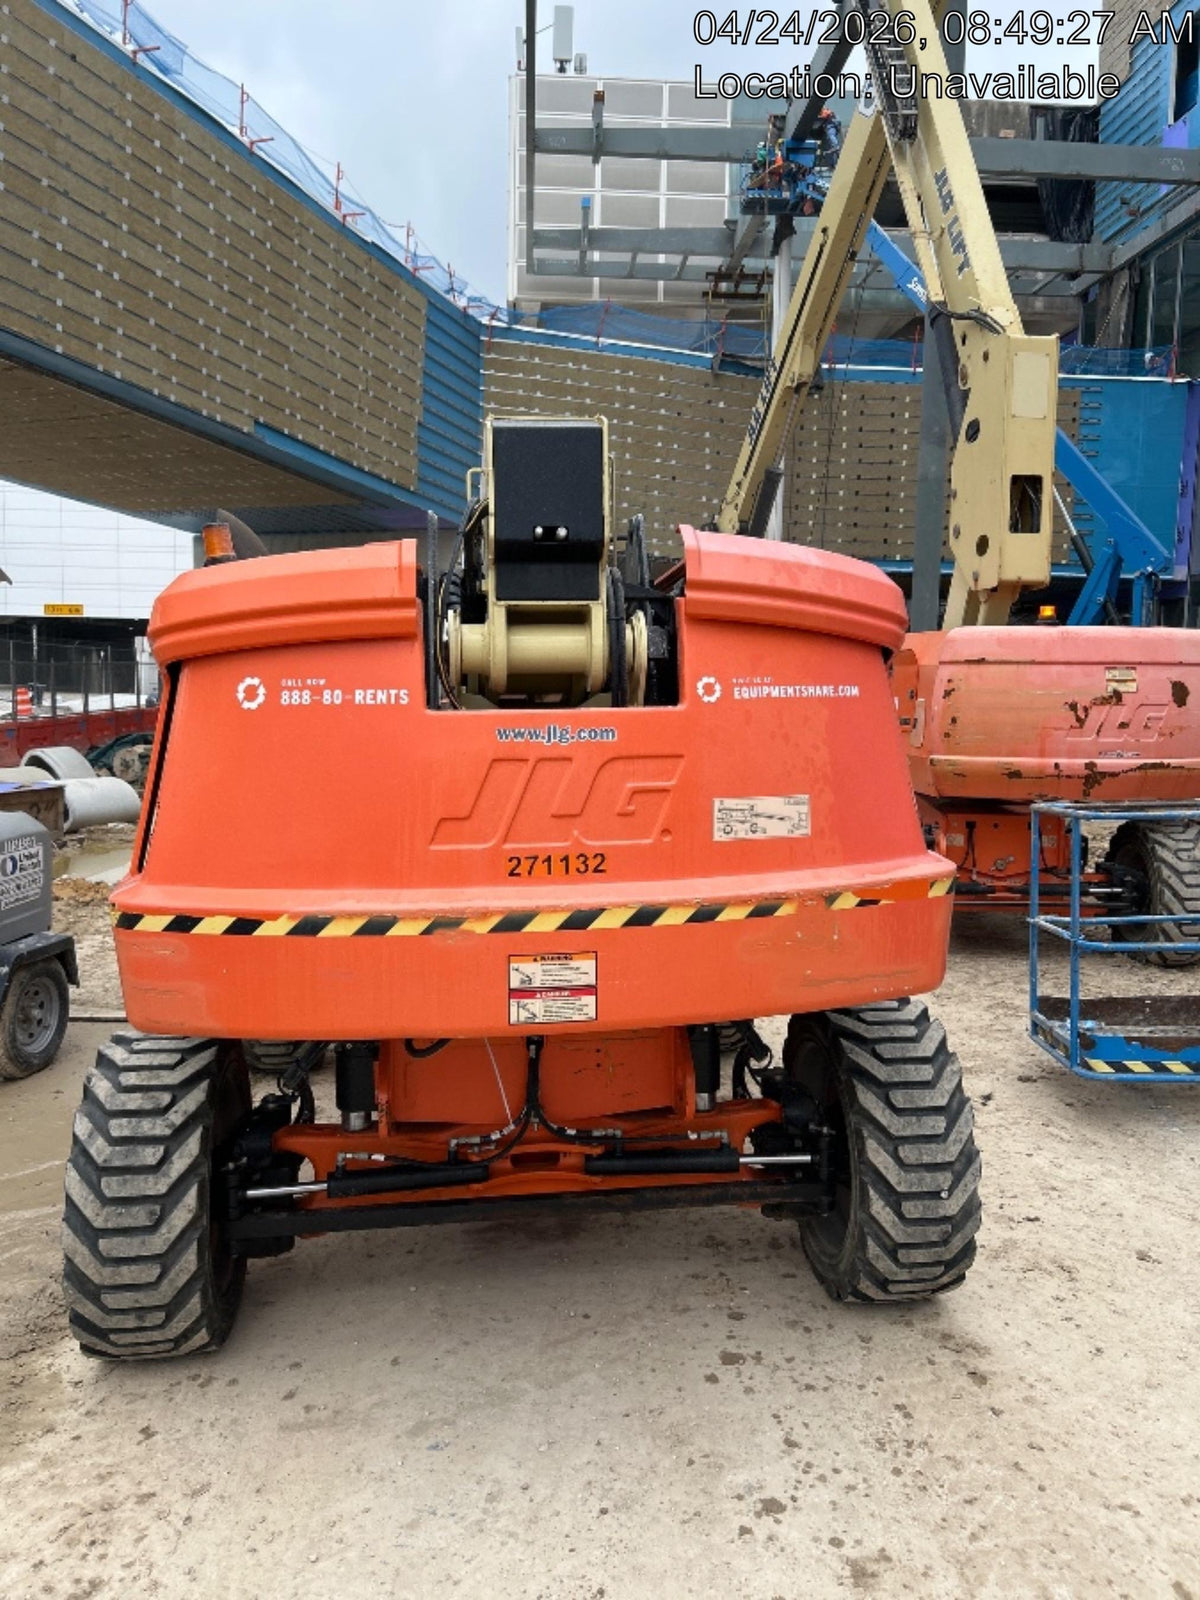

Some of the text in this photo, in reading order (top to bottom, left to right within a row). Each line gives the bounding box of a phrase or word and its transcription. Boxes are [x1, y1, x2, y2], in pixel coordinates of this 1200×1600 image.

[281, 688, 410, 705] 888-80-RENTS
[733, 685, 860, 699] EQUIPMENTSHARE.COM
[496, 725, 618, 744] www.jlg.com
[429, 755, 685, 850] JLG
[507, 853, 607, 877] 271132
